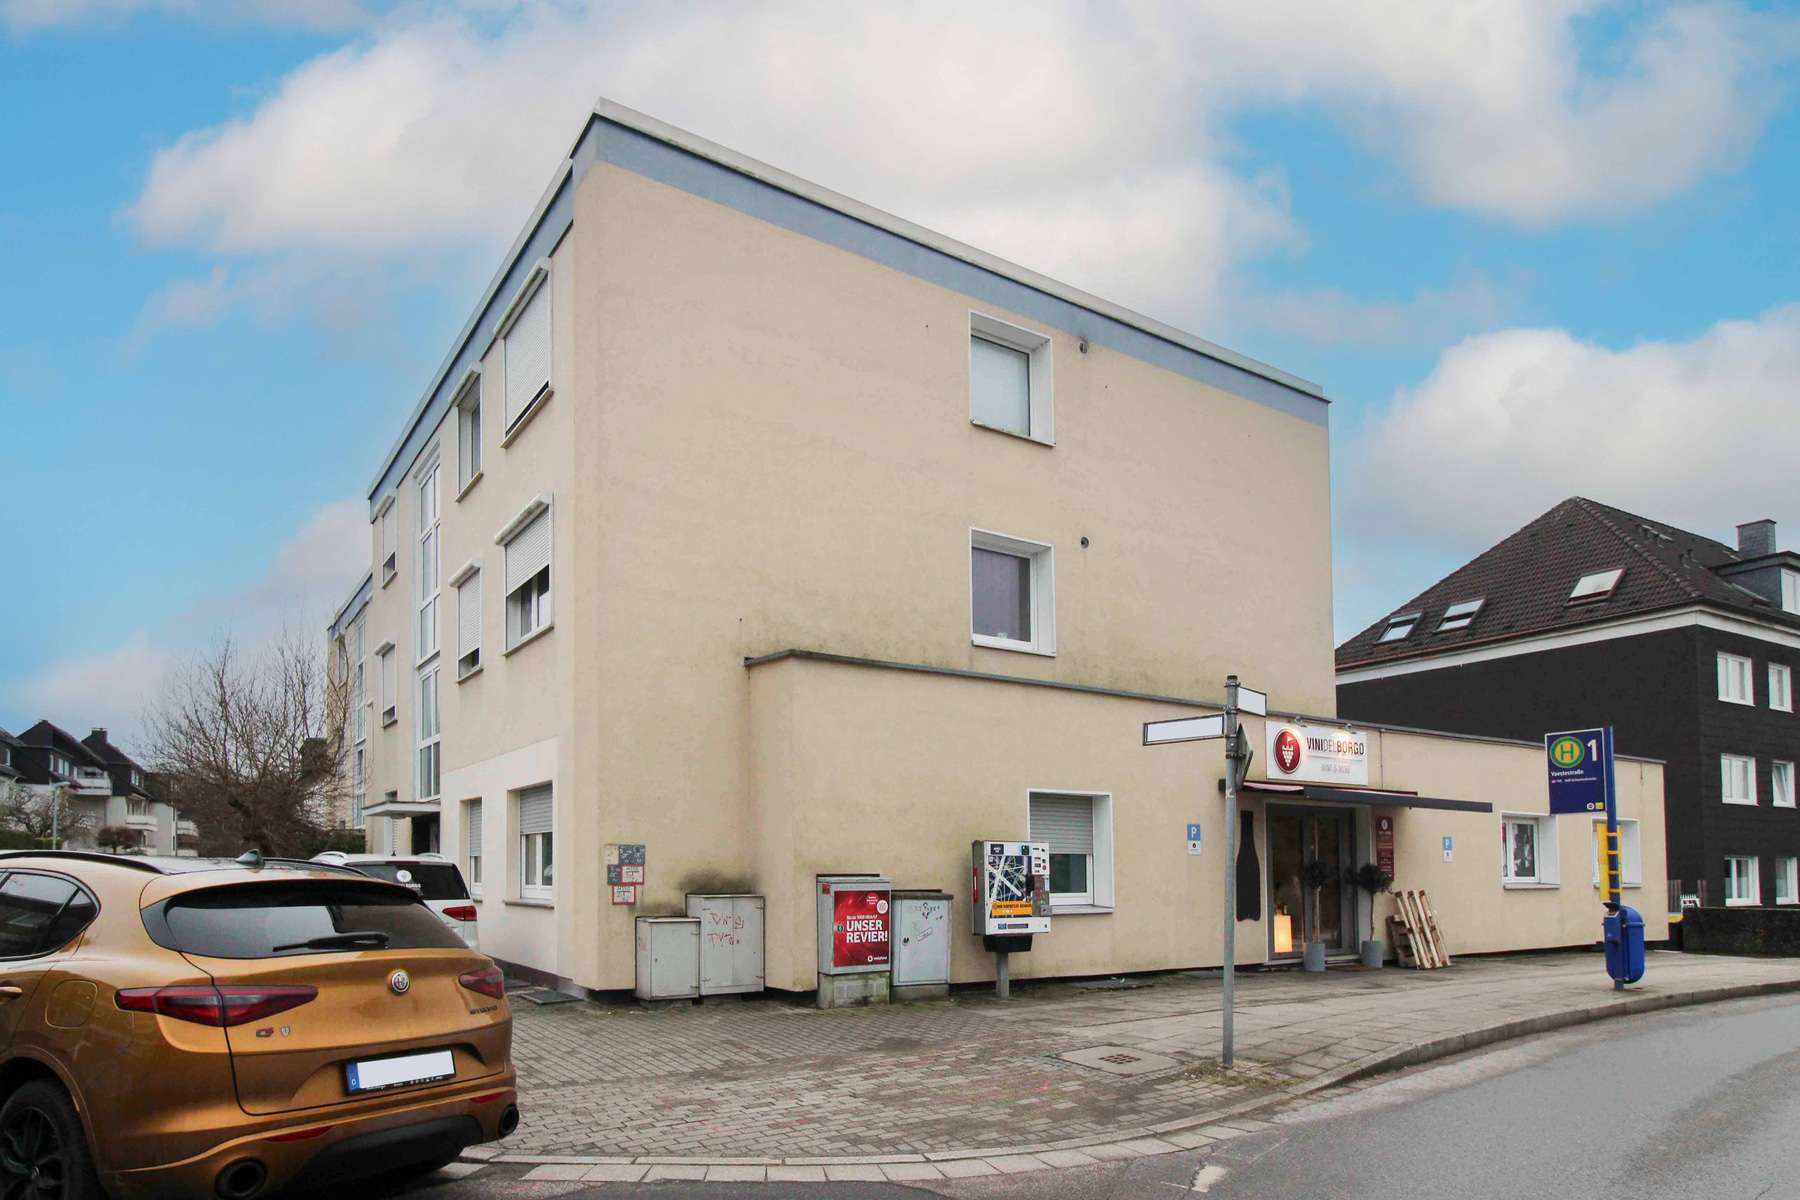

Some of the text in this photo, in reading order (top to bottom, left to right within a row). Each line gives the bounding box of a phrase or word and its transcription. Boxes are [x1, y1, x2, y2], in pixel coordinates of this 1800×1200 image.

[1560, 743, 1574, 761] H
[1587, 739, 1597, 762] 1
[1191, 826, 1197, 839] P
[846, 919, 883, 932] UNSER
[846, 930, 888, 944] REVIER!
